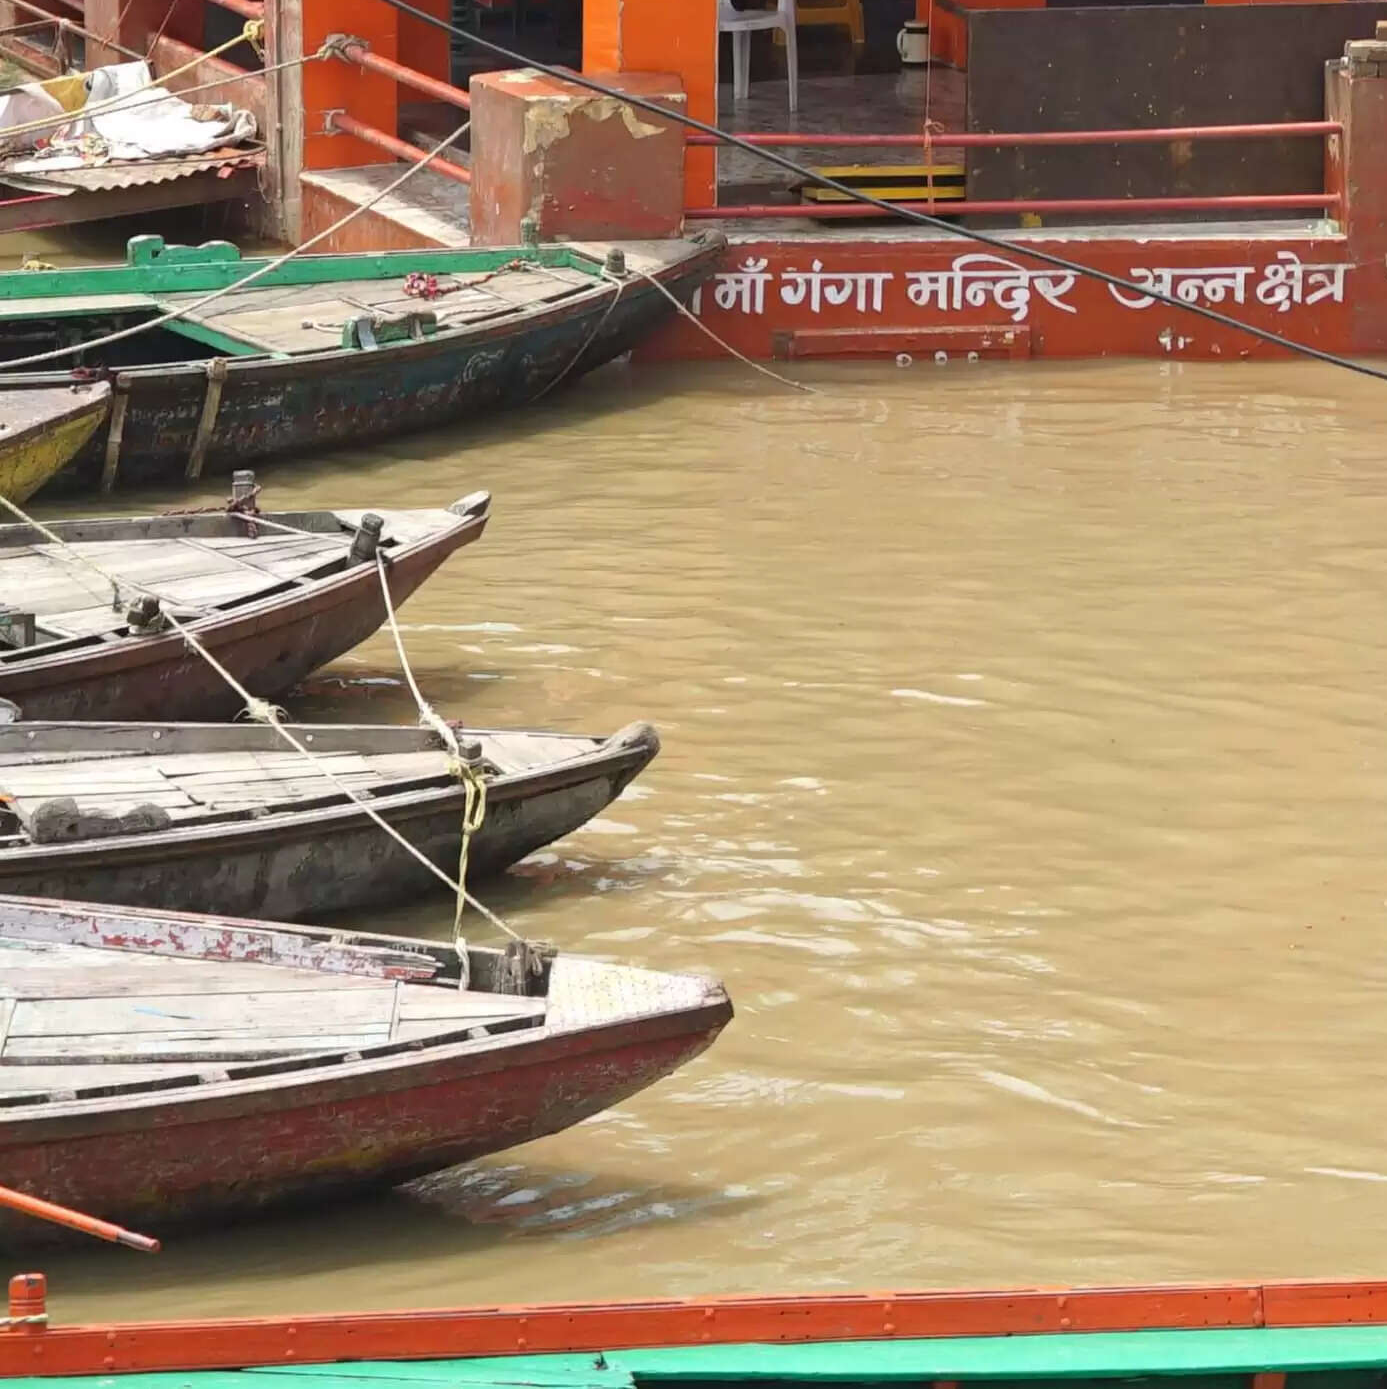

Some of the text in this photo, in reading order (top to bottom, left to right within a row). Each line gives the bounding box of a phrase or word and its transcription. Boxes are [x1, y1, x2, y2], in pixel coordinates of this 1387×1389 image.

[714, 257, 774, 315] माँ
[780, 258, 894, 314] गंगा
[905, 253, 1082, 322] मन्दिर
[1108, 266, 1256, 310] अन्न
[1256, 250, 1358, 313] क्षेत्र
